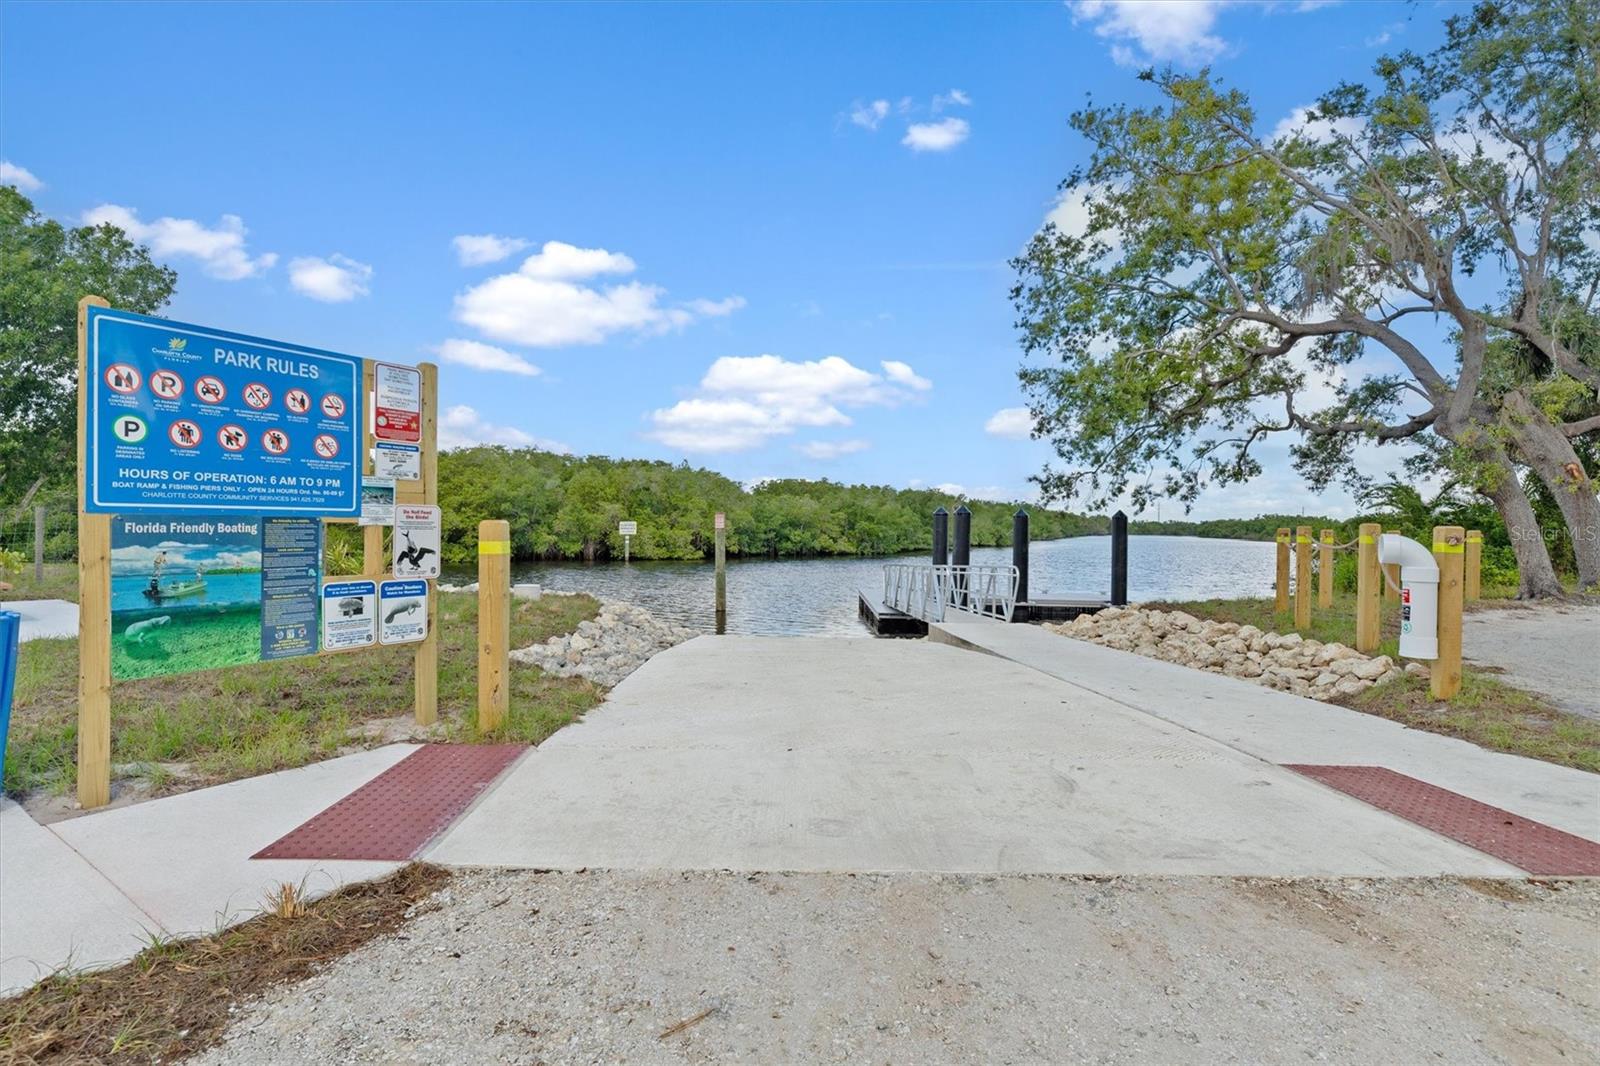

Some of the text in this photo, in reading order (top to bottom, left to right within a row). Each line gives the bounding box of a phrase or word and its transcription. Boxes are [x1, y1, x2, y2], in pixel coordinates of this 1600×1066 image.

[214, 348, 319, 379] PARK RULES
[124, 421, 140, 437] P
[119, 468, 340, 487] HOURS OF OPERATION: 6 AM TO 9 PM
[124, 522, 258, 535] Florida Friendly Boating
